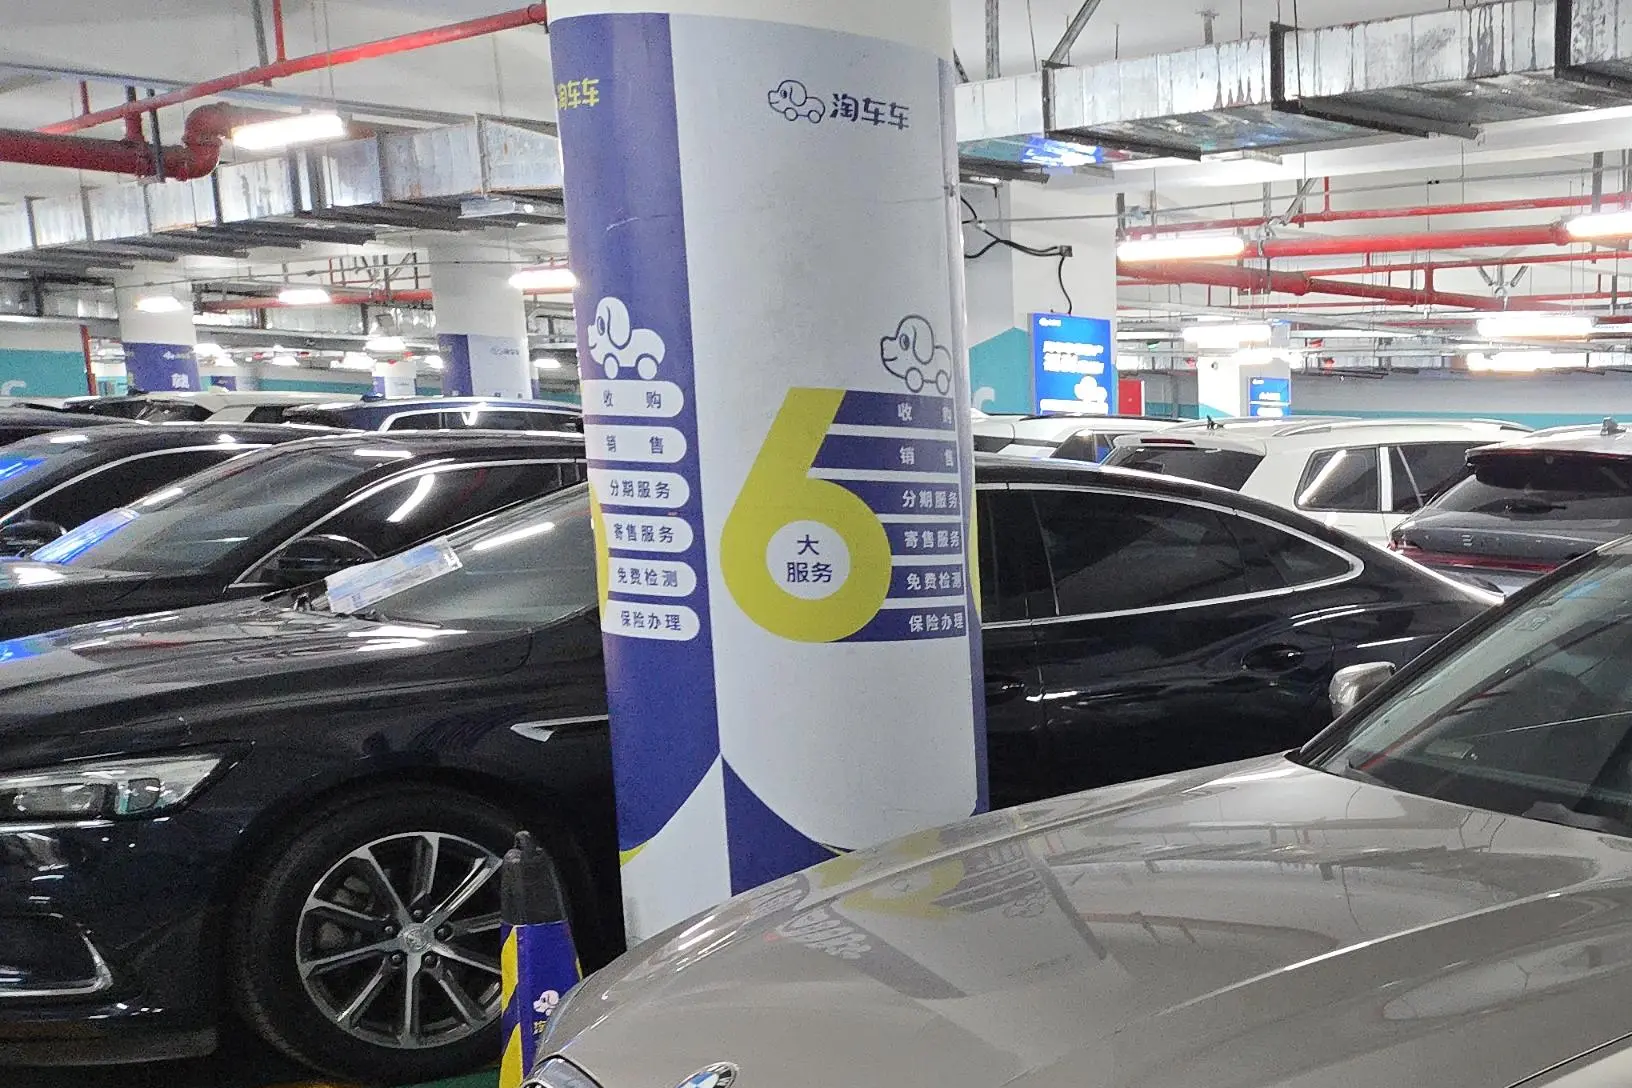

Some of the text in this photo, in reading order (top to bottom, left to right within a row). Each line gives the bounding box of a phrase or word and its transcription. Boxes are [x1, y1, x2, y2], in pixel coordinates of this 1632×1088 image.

[830, 93, 909, 130] 淘车车
[610, 480, 670, 499] 分期服务
[902, 490, 960, 508] 分期服务
[613, 523, 674, 543] 寄售服务
[904, 530, 961, 549] 寄售服务
[797, 534, 820, 556] 大
[617, 567, 678, 587] 免费检测
[786, 562, 833, 583] 服务
[906, 572, 962, 590] 免费检测
[620, 610, 681, 631] 保险办理
[909, 612, 964, 632] 保险办理
